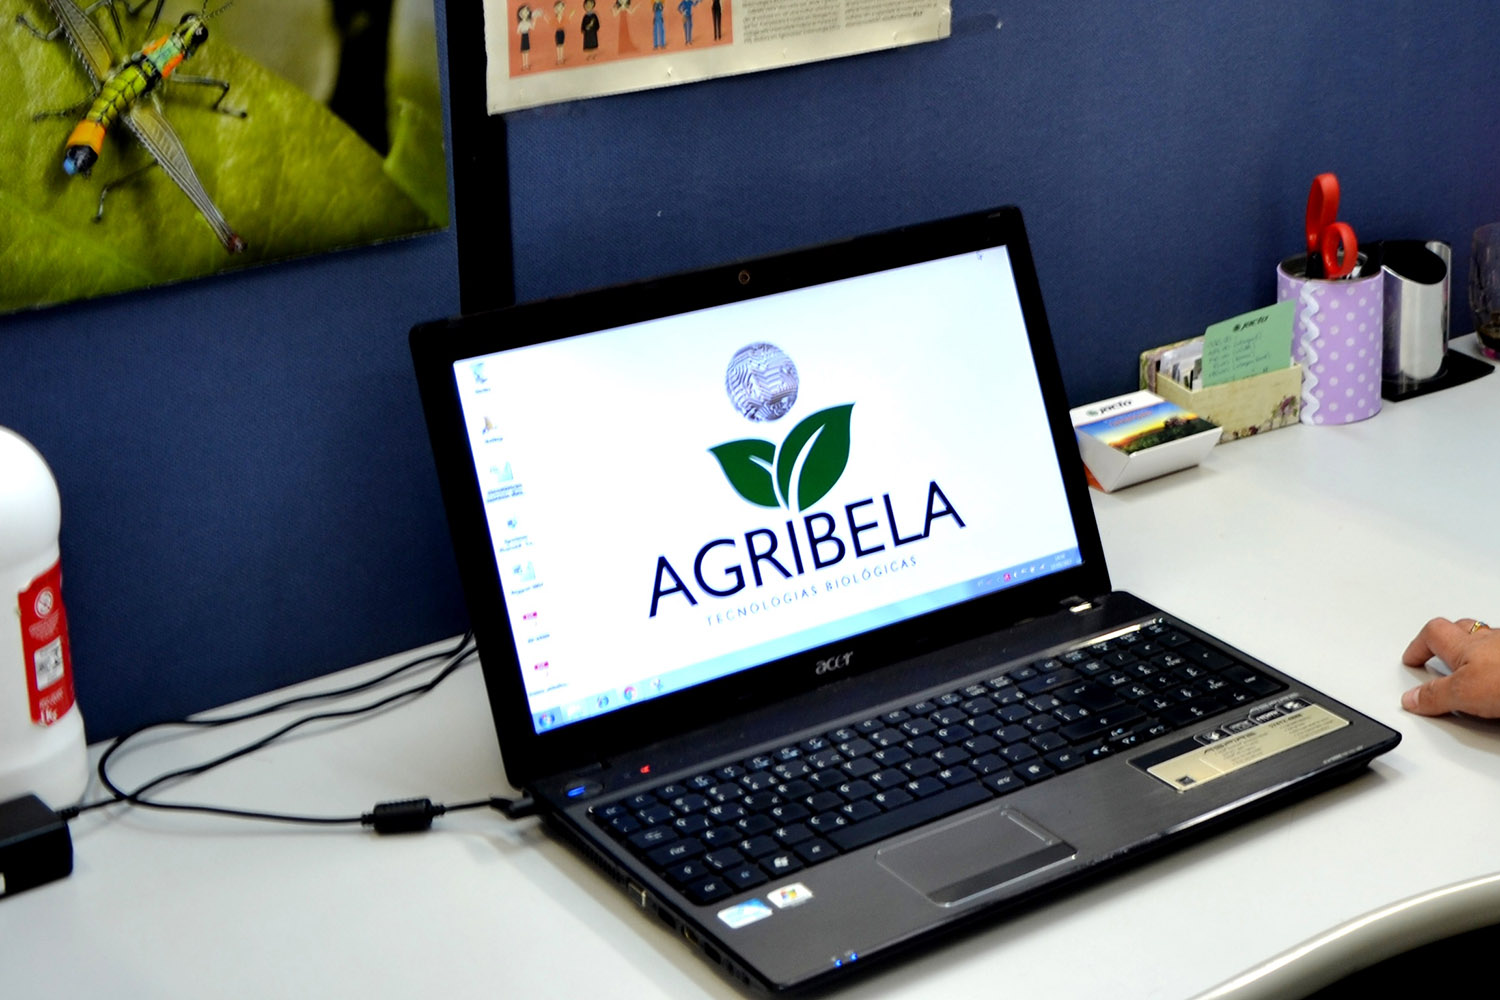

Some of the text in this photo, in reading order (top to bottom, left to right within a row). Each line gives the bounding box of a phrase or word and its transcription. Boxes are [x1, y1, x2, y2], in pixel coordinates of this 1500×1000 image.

[648, 479, 967, 619] AGRIBELA
[824, 555, 918, 593] BIOLÓGICAS
[814, 650, 854, 676] acer
